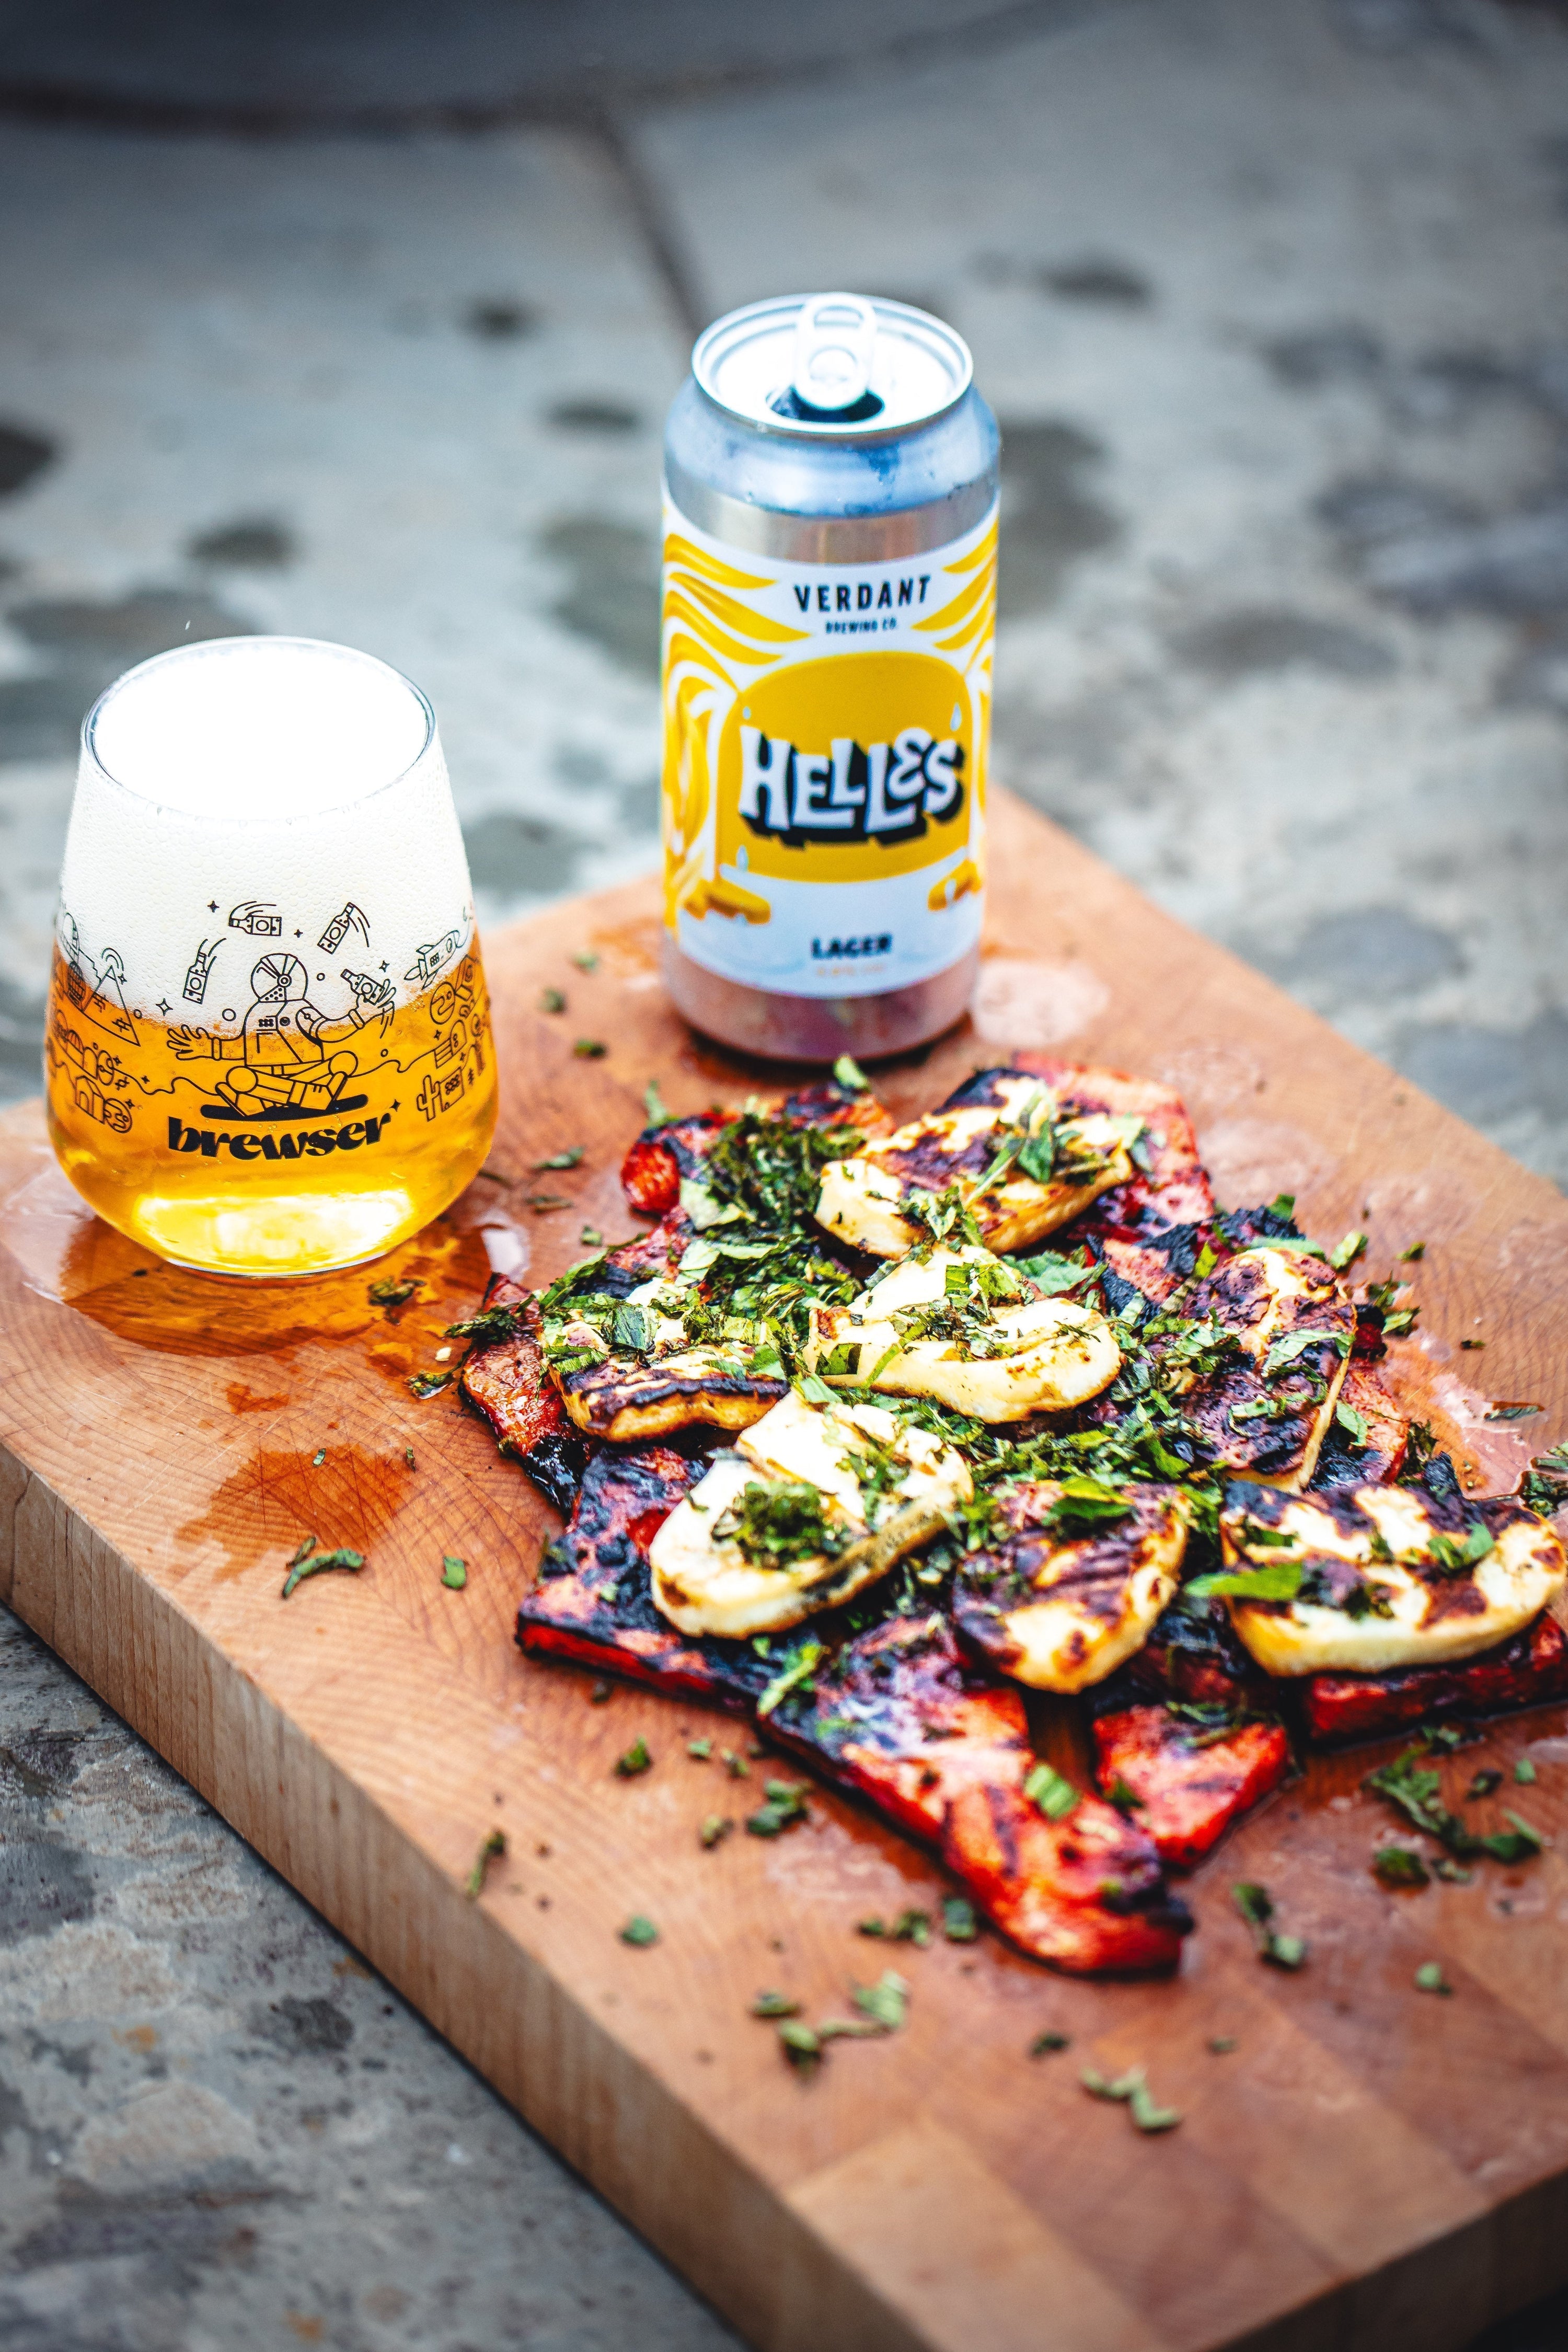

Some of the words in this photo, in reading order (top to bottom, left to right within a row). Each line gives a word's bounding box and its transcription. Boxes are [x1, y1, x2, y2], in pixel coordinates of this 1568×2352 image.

[793, 575, 931, 612] VERDANT
[739, 725, 965, 848] HELLES
[811, 931, 893, 959] LAGER
[168, 1113, 391, 1160] brewser
